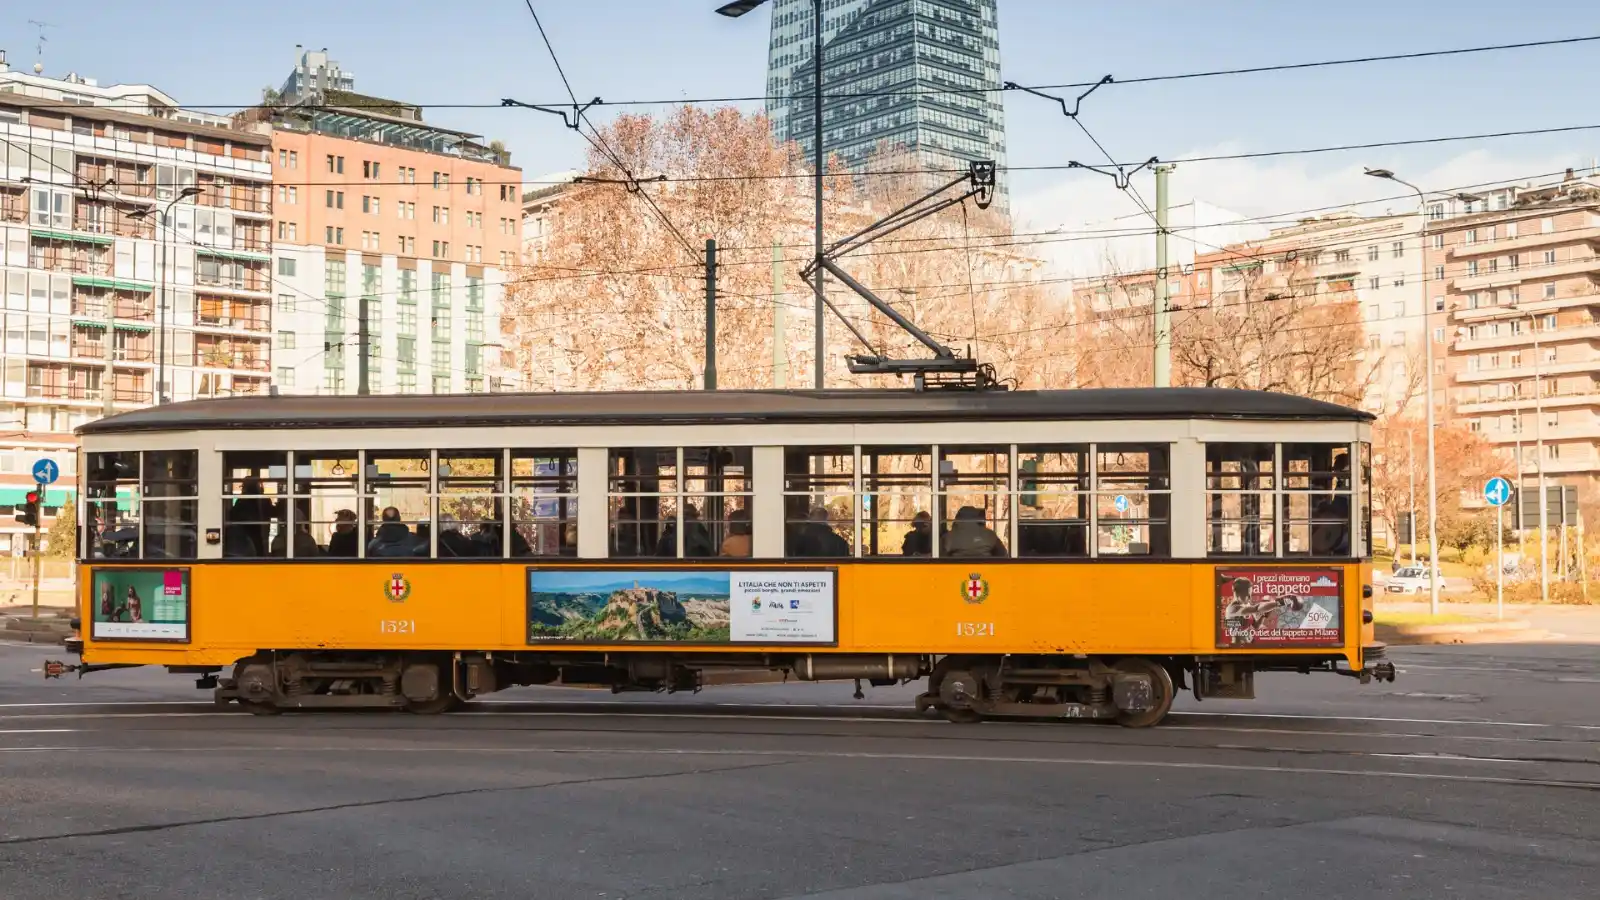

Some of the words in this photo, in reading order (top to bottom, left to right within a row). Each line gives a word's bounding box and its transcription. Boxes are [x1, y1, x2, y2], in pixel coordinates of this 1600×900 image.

[1257, 574, 1277, 583] prezzi
[1253, 582, 1264, 594] al
[1266, 582, 1311, 596] tappeto
[1307, 612, 1329, 622] 50%
[381, 619, 415, 634] 1521
[956, 622, 995, 636] 1521
[1271, 628, 1281, 636] del
[1281, 629, 1308, 638] tappeto
[1314, 628, 1338, 636] Milano
